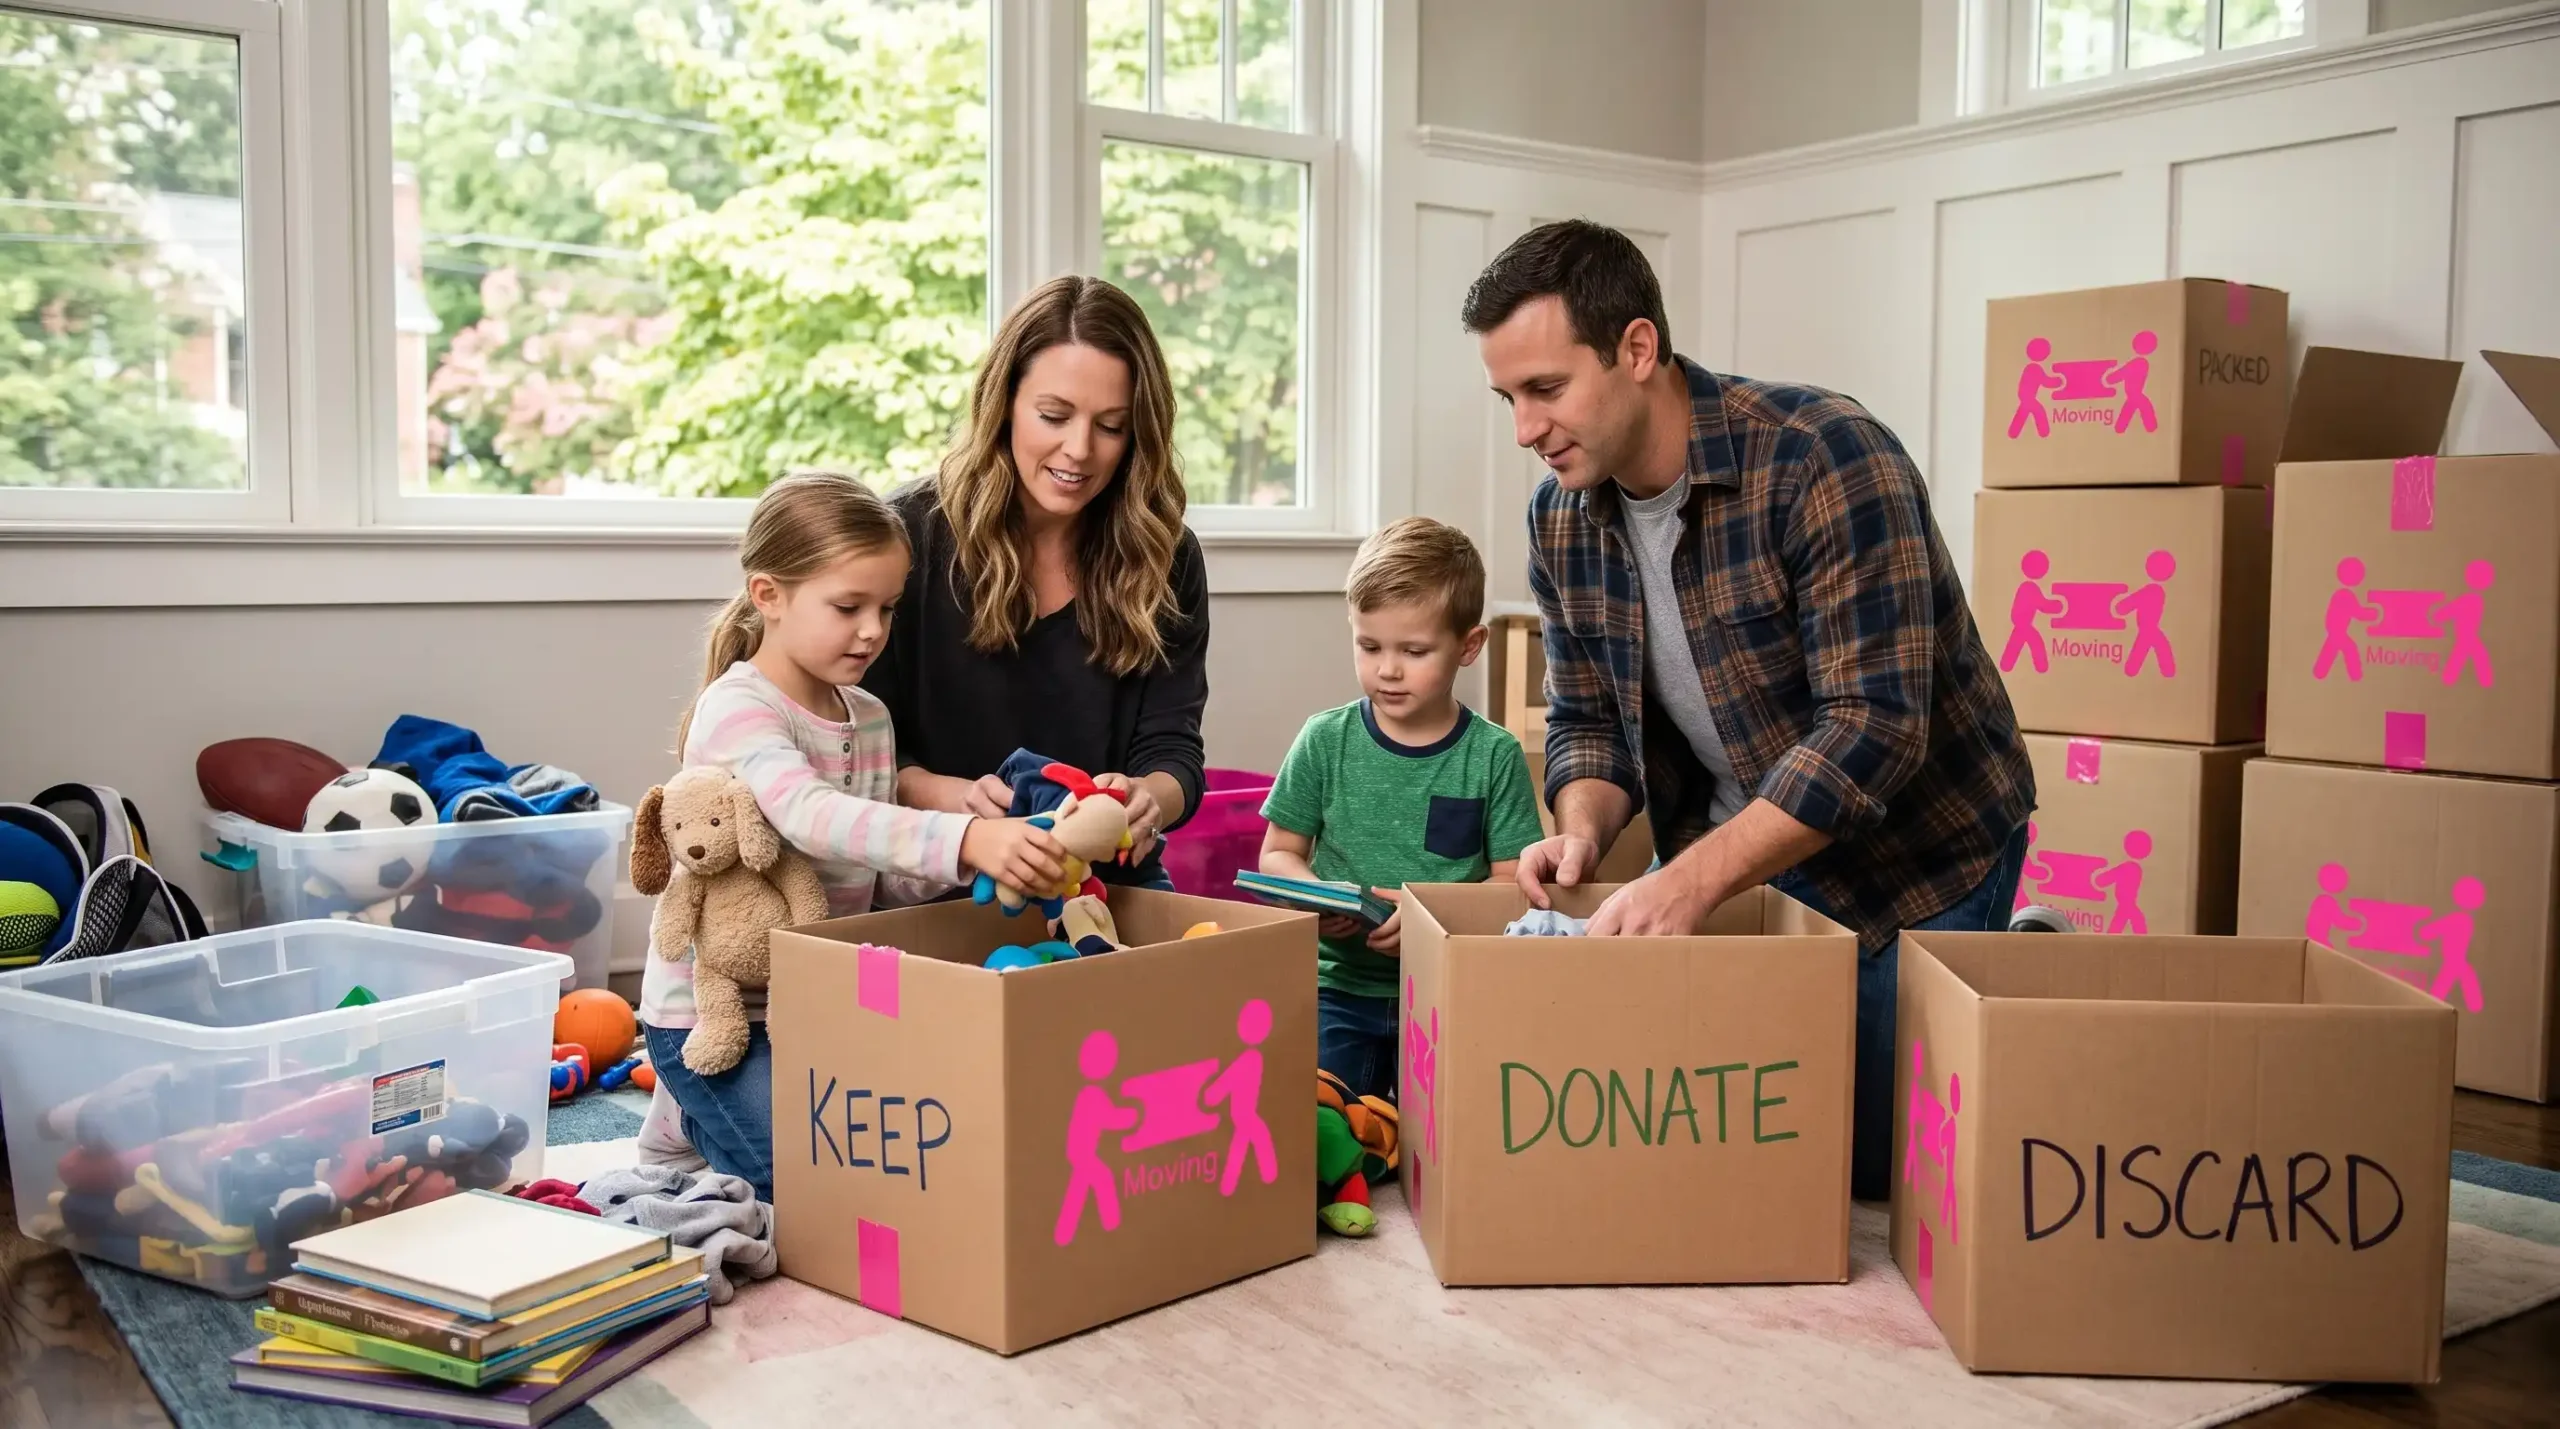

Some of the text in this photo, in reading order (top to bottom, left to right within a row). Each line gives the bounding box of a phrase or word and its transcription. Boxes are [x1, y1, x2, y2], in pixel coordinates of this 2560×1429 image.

[2199, 349, 2270, 386] PACKED
[2052, 406, 2114, 426] Moving
[2052, 638, 2123, 664] Moving
[2367, 645, 2440, 674] Moving
[2037, 903, 2104, 932] ving
[1500, 1061, 1799, 1154] DONATE
[809, 1067, 952, 1190] KEEP
[1123, 1150, 1219, 1199] Moving
[2022, 1138, 2404, 1251] DISCARD
